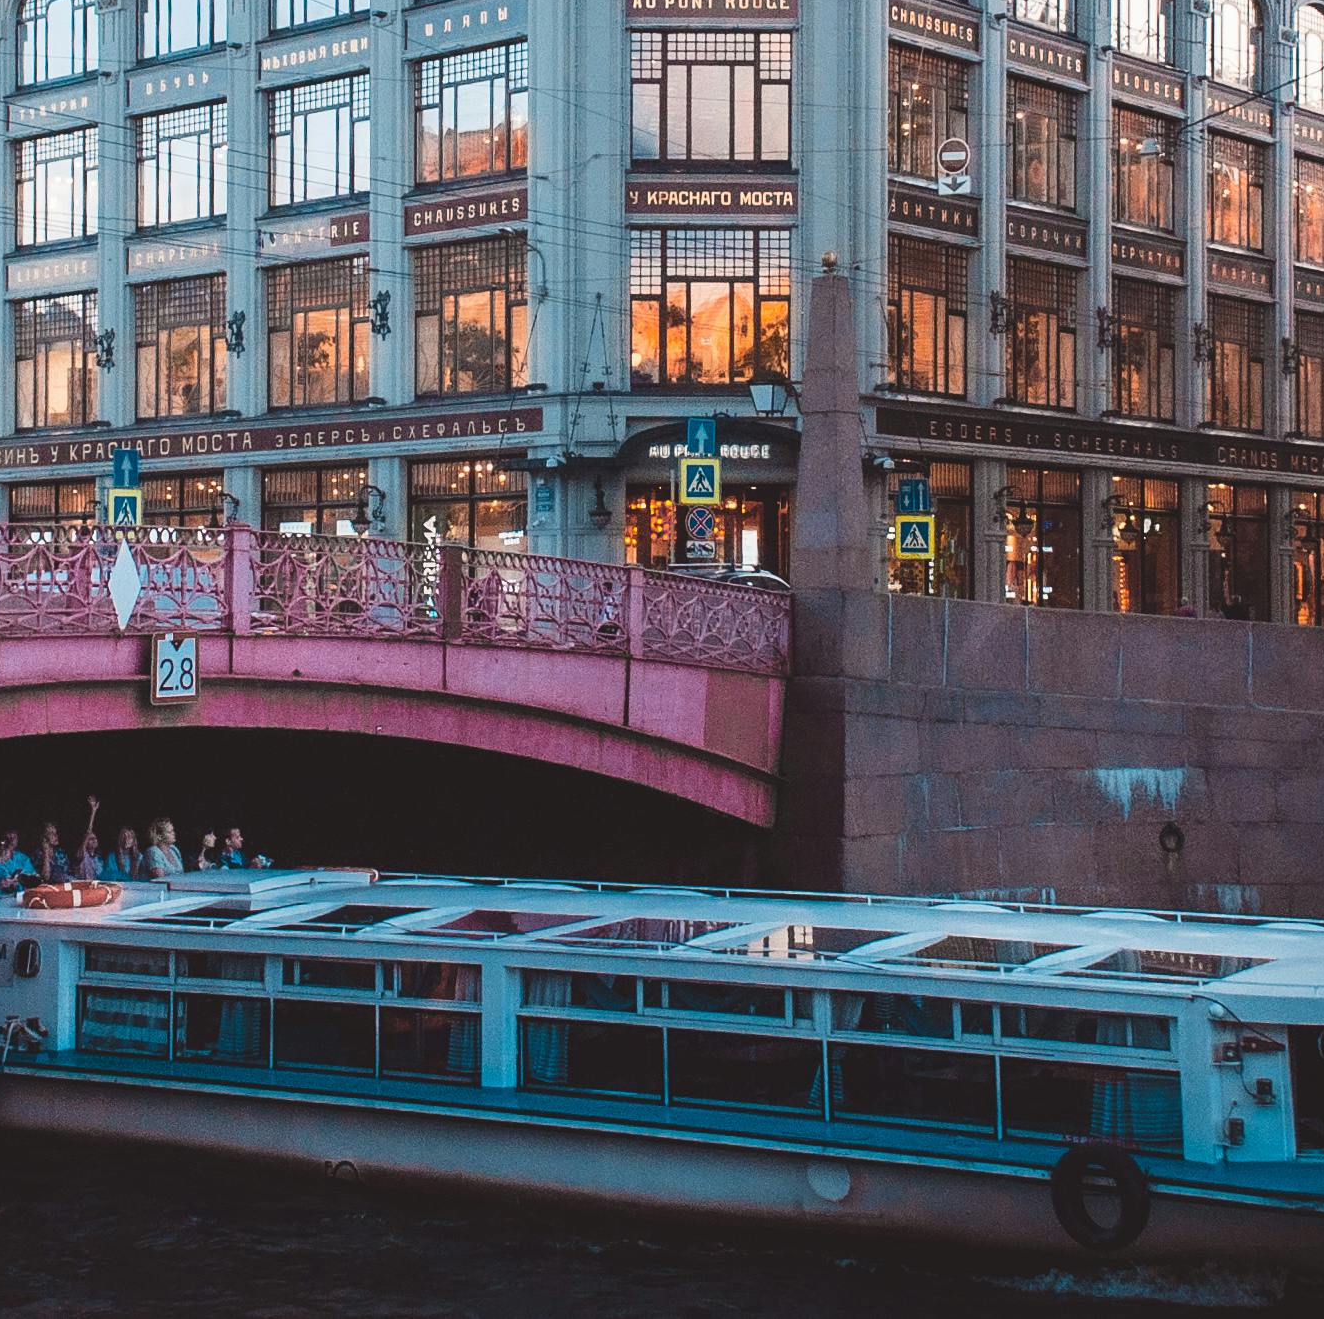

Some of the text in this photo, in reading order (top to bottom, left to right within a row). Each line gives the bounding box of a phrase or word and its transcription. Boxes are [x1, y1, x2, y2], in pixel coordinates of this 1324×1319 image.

[425, 7, 508, 37] ШЛЯПЫ
[891, 5, 973, 43] CHAUSSURES
[332, 37, 368, 57] ВЕЩИ
[1009, 39, 1082, 73] CRAVATES
[145, 71, 209, 95] ОБУВЬ
[1114, 69, 1182, 100] BLOUSES
[413, 197, 520, 227] CHAUSSURES
[629, 191, 793, 206] У КРАСНАГО МОСТА
[890, 198, 973, 228] ЗОНТИКИ
[1009, 223, 1082, 249] СОРОЧКИ
[50, 445, 59, 463] У
[69, 437, 171, 462] КРАСАГО
[182, 431, 253, 455] МОСТА
[275, 429, 370, 448] ЭСДЕРСЪ
[392, 417, 525, 440] СХЕФАЛЬСЪ
[930, 420, 1012, 443] ESDERS
[1054, 433, 1179, 459] SCHEEFHALS
[648, 444, 670, 459] AU
[720, 444, 771, 459] ROUGE
[1217, 446, 1278, 469] GRANDS
[159, 657, 194, 692] 2.8
